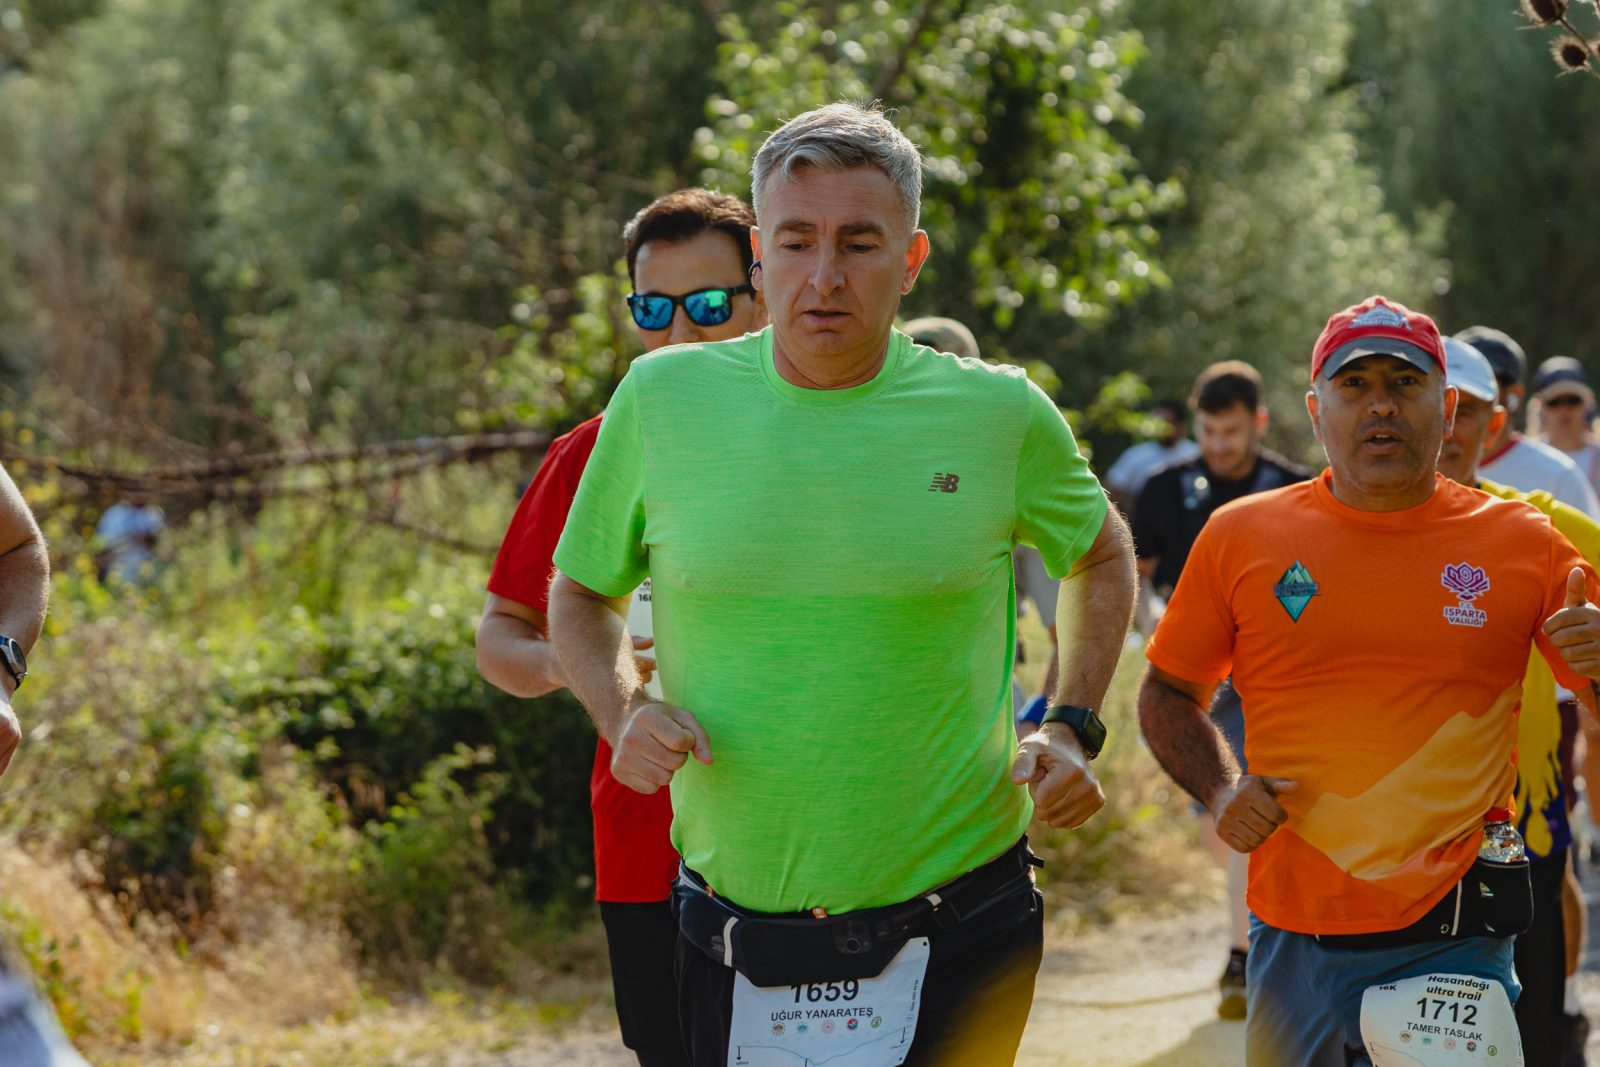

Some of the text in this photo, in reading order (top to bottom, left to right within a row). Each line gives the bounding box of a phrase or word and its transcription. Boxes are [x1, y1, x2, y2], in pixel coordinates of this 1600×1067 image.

[1445, 608, 1485, 620] ISPARTA
[790, 979, 859, 1003] 1659
[1427, 975, 1490, 991] Hasandağı
[1426, 986, 1482, 1002] ultra trail
[771, 1007, 873, 1021] UĞUR YANARATEŞ
[1416, 997, 1478, 1026] 1712
[1407, 1022, 1482, 1041] TAMER TASLAK
